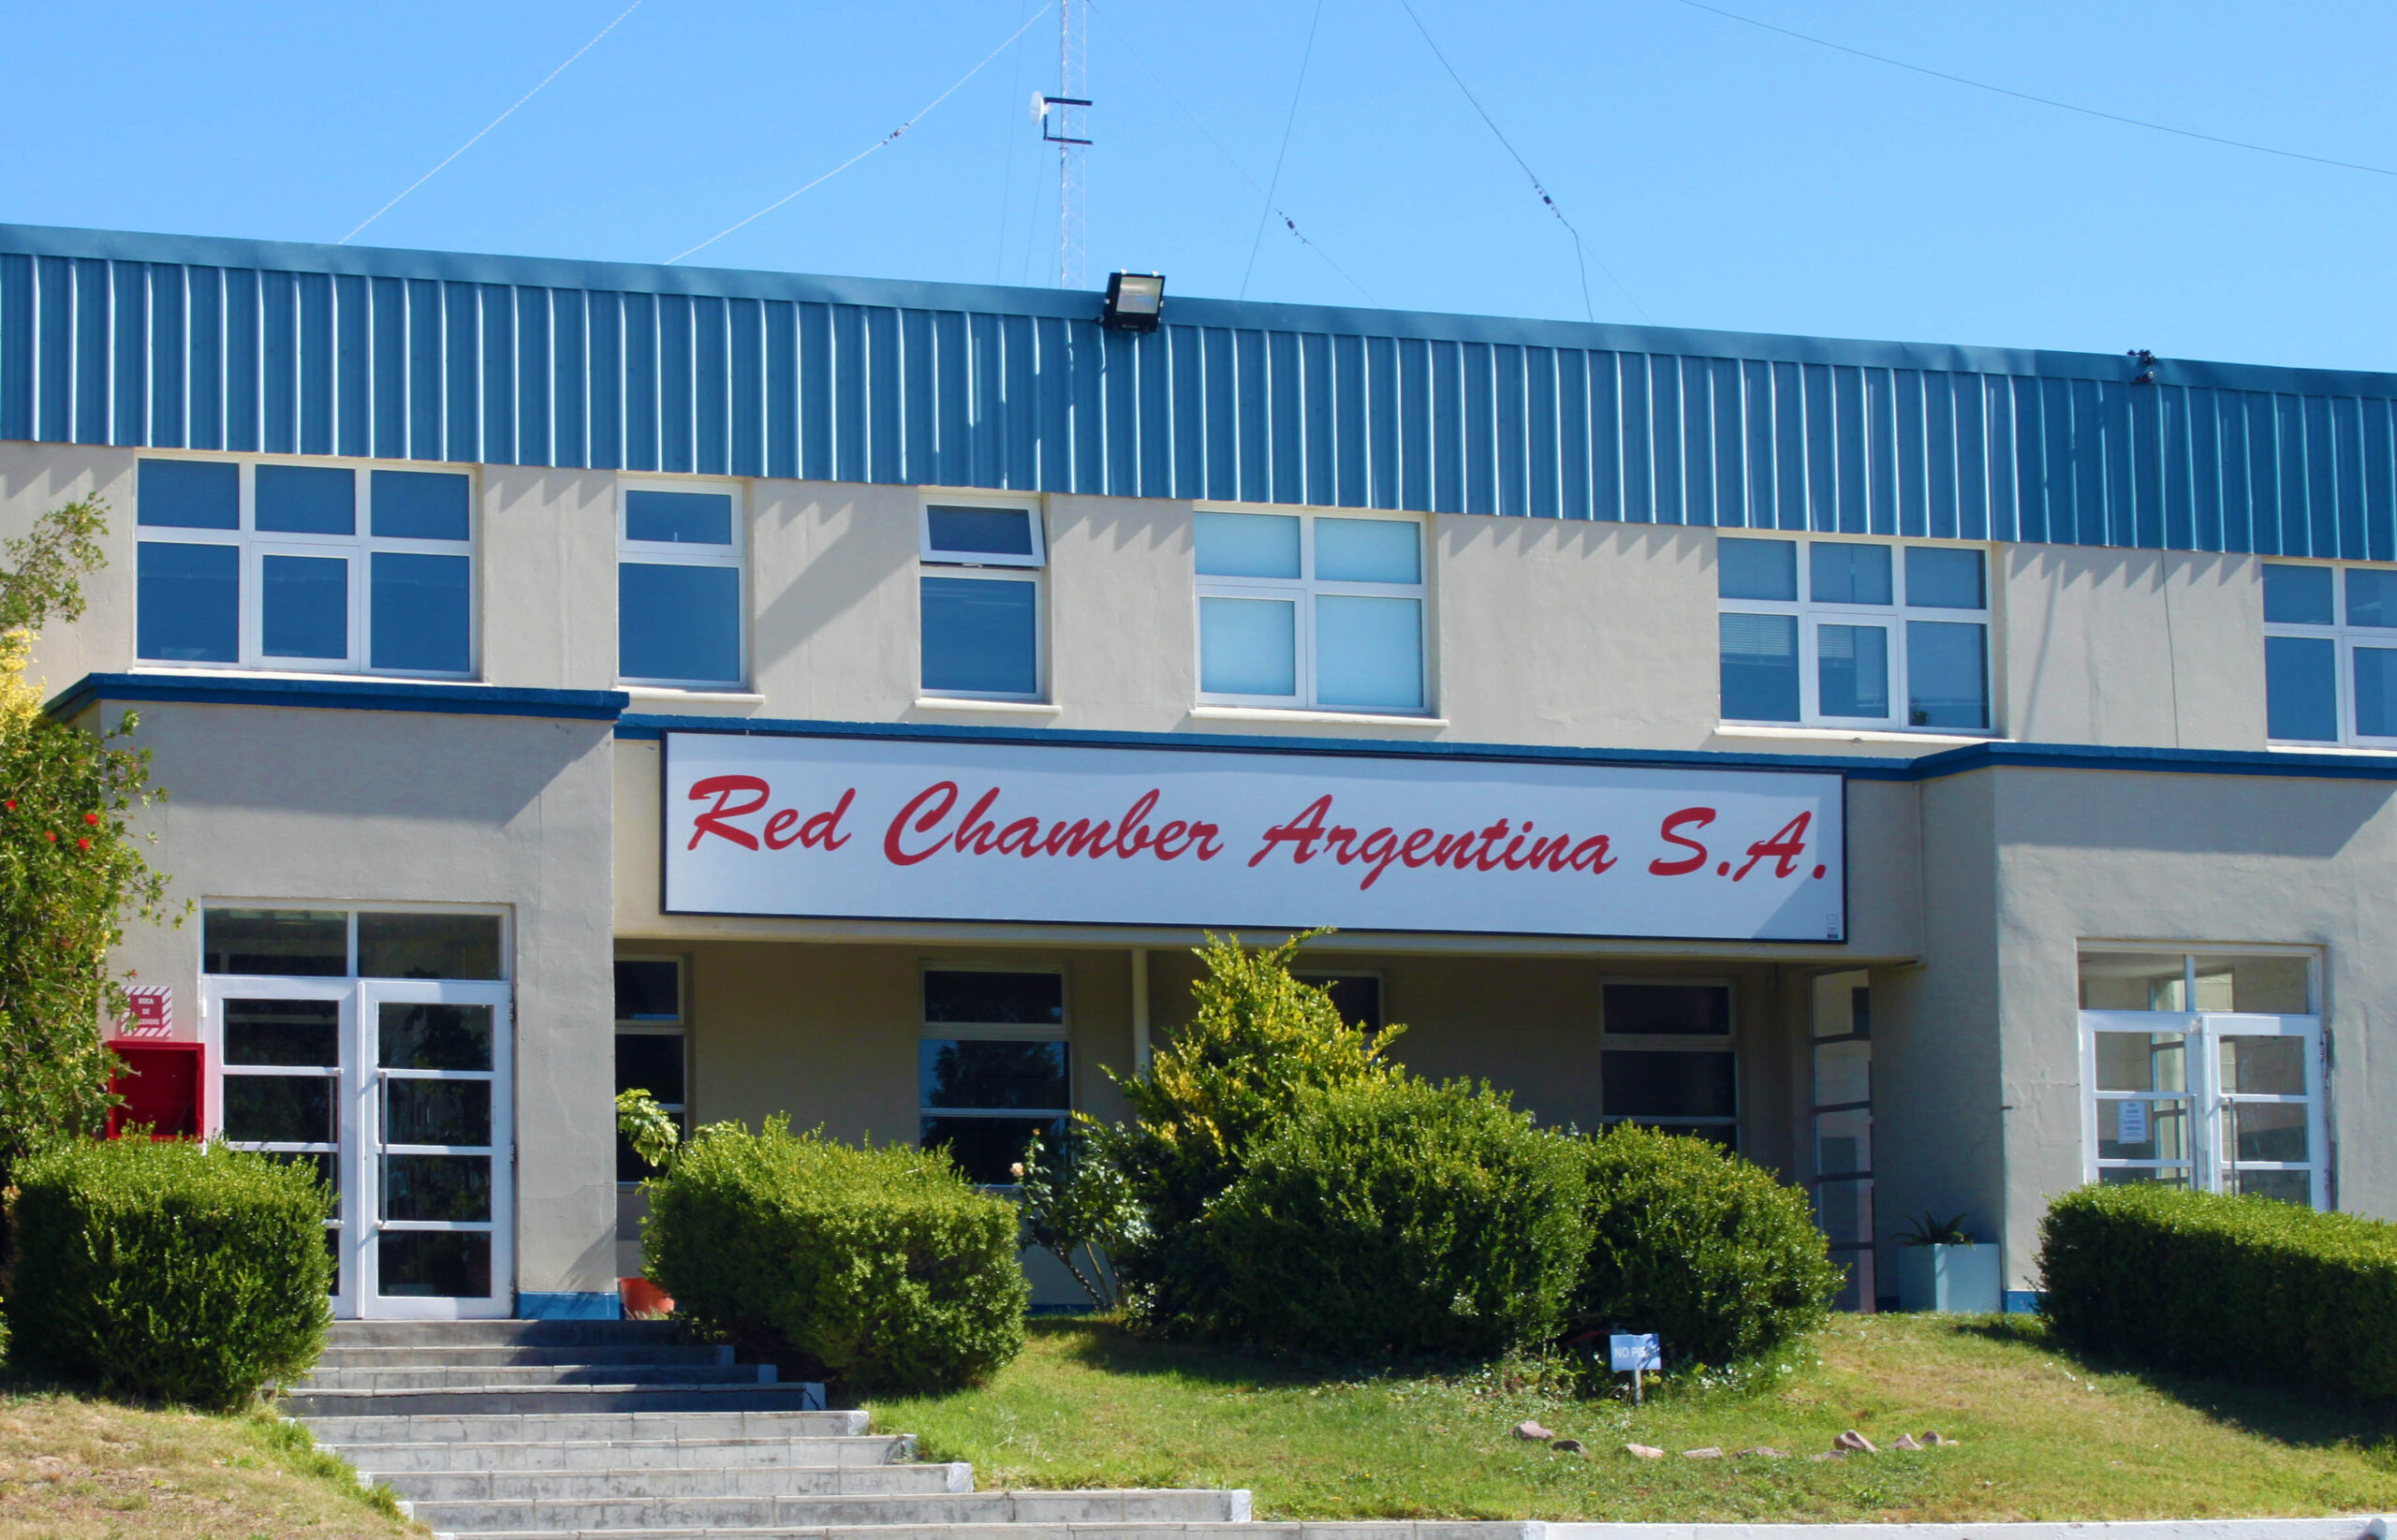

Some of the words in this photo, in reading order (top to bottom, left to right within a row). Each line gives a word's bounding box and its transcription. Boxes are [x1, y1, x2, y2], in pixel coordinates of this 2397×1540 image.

[687, 774, 856, 851] Red
[884, 781, 1223, 866] Chamber
[1248, 795, 1617, 890] Argentina
[1649, 807, 1827, 882] S.A.
[1614, 1346, 1629, 1358] NO
